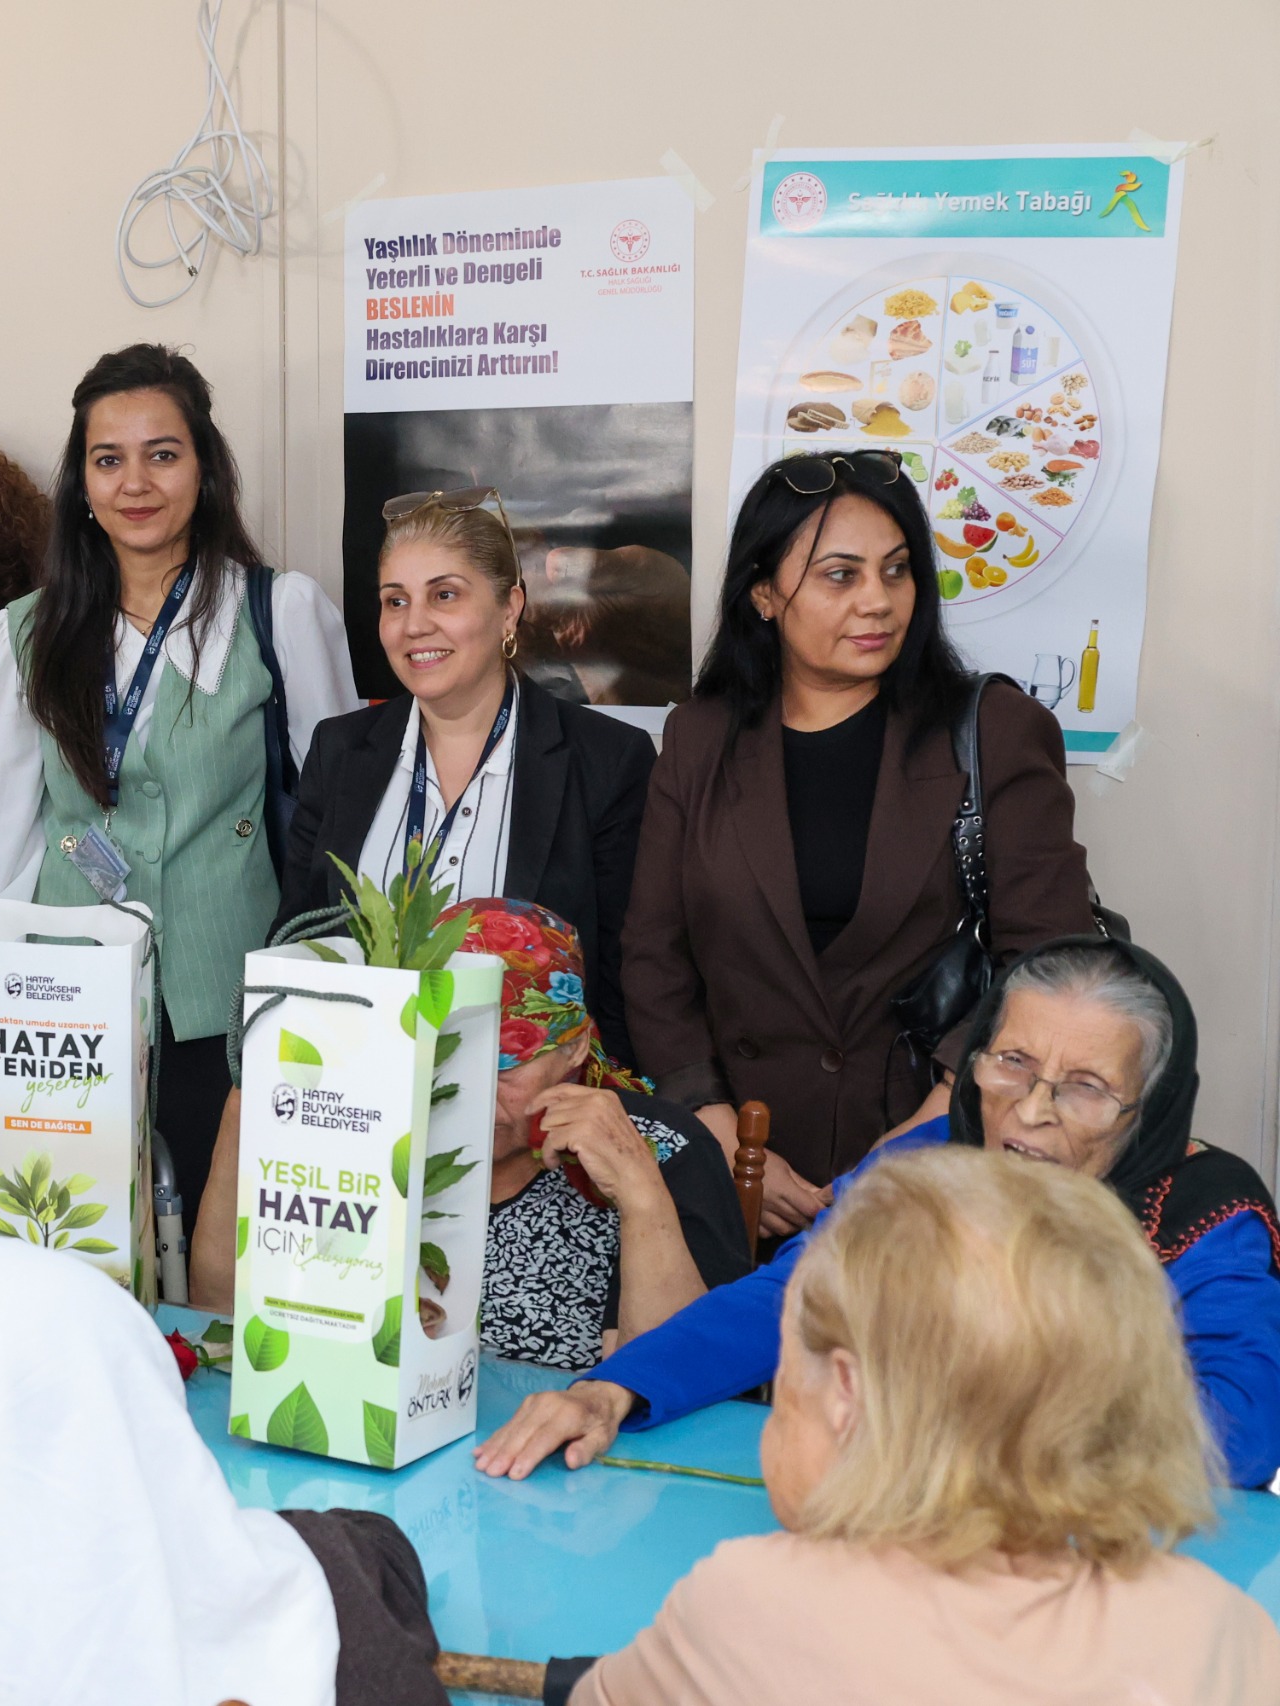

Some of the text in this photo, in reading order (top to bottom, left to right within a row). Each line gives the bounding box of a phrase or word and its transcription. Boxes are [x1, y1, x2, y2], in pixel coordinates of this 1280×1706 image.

[935, 191, 1009, 212] Yemek
[1017, 190, 1091, 216] Tabağı
[364, 226, 561, 262] Yaşlılık Döneminde
[366, 258, 543, 290] Yeterli ve Dengeli
[580, 263, 680, 278] T.C. SAĞLIK BAKANLIĞI
[608, 278, 624, 286] HALK
[597, 288, 619, 296] GENEL
[366, 292, 455, 321] BESLENİN
[366, 322, 547, 351] Hastalıklara Karşı
[366, 350, 559, 381] Direncinizi Arttırın!
[26, 975, 55, 984] HATAY
[26, 1019, 56, 1028] umuda
[93, 1023, 109, 1031] yol.
[302, 1088, 344, 1103] HATAY
[10, 1119, 85, 1133] SEN DE BAĞIŞLA
[259, 1158, 381, 1198] YEŞİL BİR
[259, 1188, 378, 1235] HATAY
